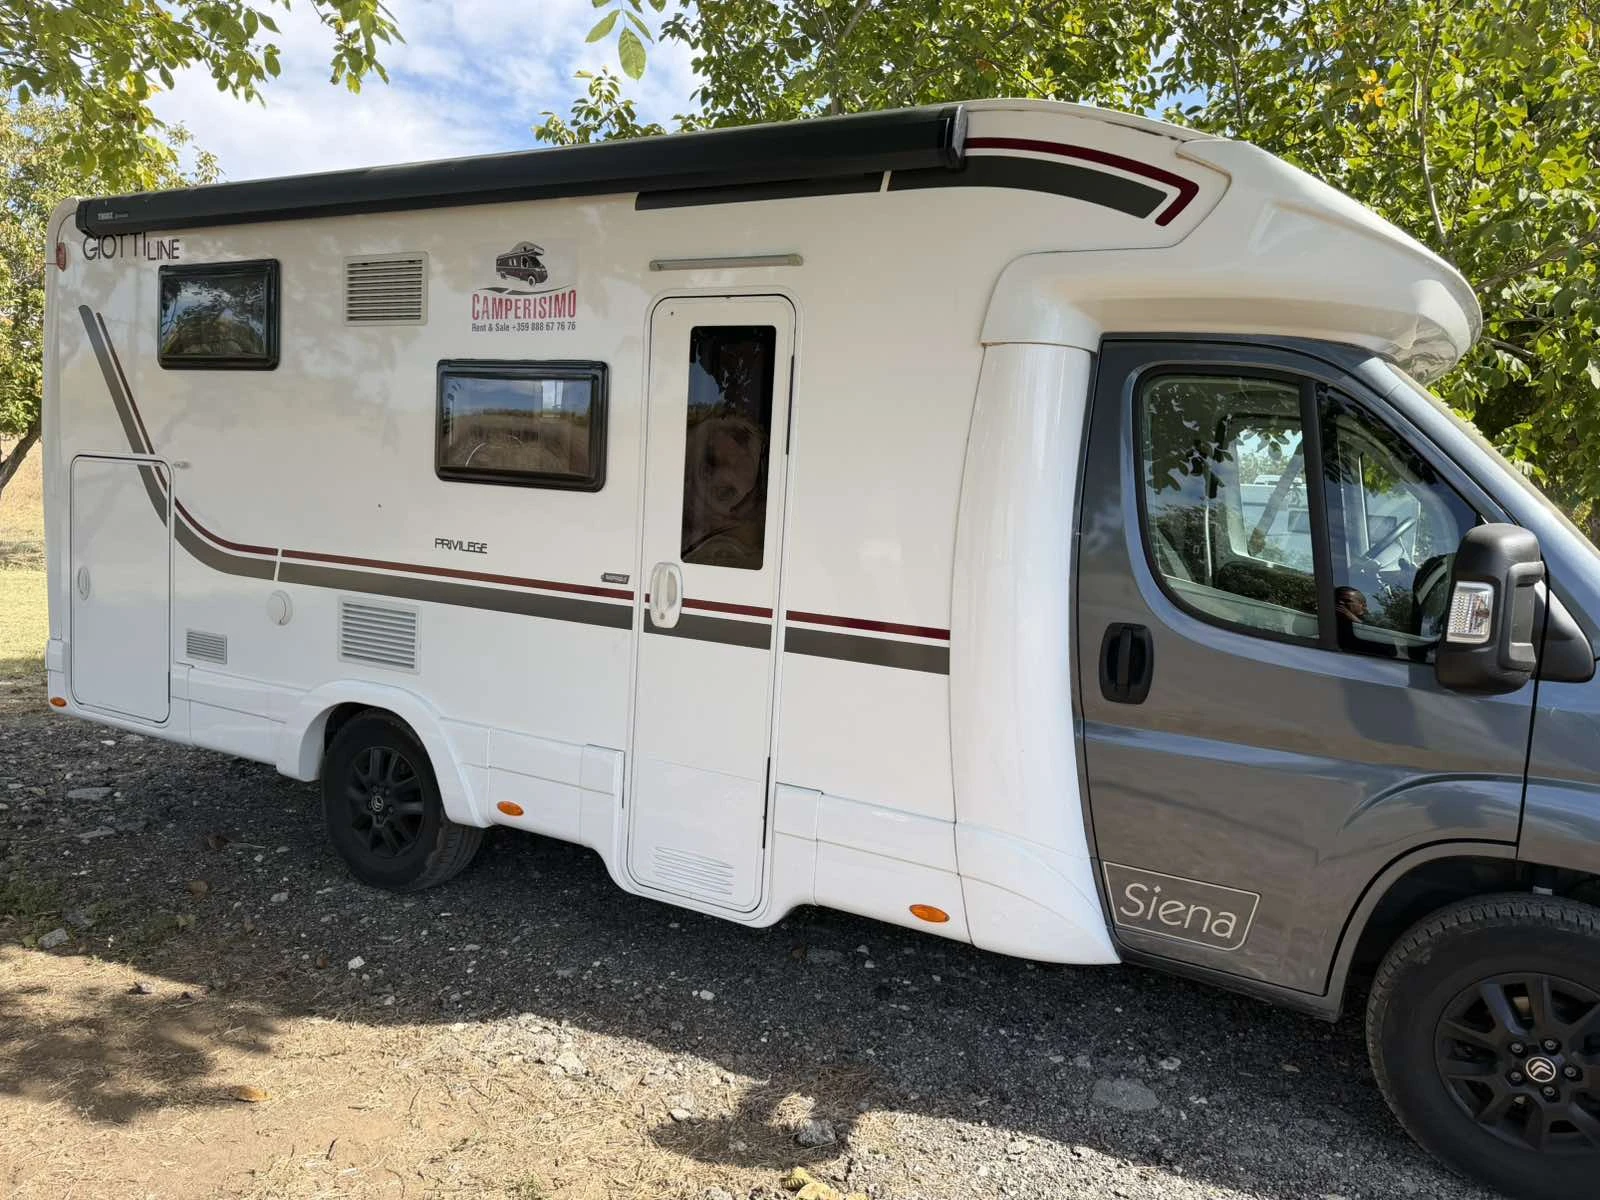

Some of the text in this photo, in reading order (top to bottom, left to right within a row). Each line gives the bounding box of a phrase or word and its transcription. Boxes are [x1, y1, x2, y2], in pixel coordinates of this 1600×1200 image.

[472, 289, 577, 320] CAMPERISIMO
[471, 323, 487, 333] Rent
[488, 323, 494, 332] &
[495, 322, 510, 332] Sale
[511, 322, 530, 332] +359
[545, 322, 555, 331] 67
[556, 321, 566, 331] 76
[567, 321, 577, 331] 76
[434, 537, 488, 555] PRIVILEGE
[1119, 882, 1238, 939] Siena
